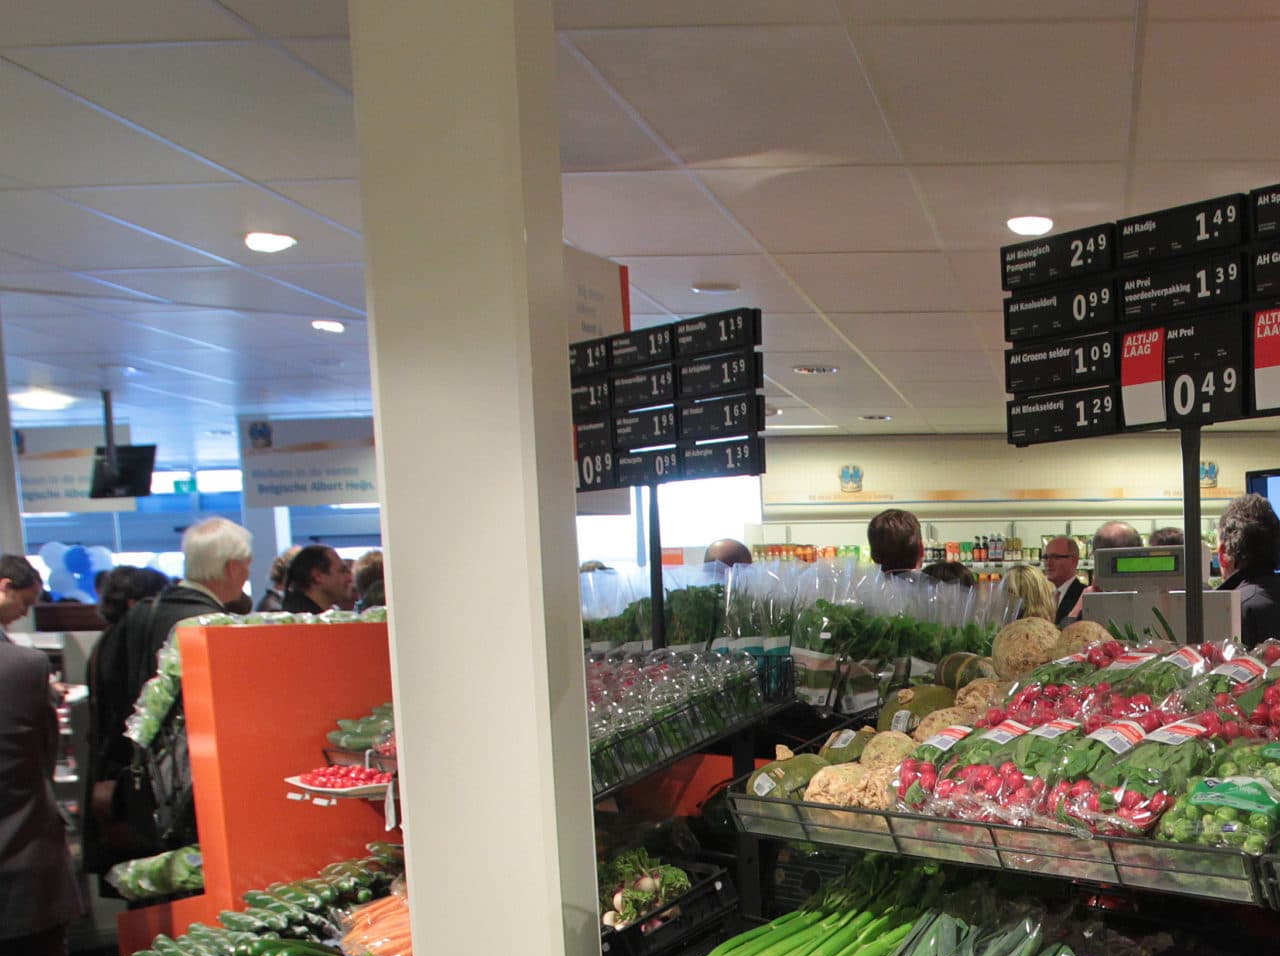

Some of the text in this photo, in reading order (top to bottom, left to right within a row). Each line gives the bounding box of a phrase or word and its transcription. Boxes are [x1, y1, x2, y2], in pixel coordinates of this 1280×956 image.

[1257, 195, 1270, 206] AH
[1123, 224, 1134, 235] AH
[1196, 205, 1236, 241] 1.49
[1070, 234, 1107, 267] 2.49
[1256, 254, 1270, 266] AH
[1124, 277, 1151, 292] AH Prei
[1196, 263, 1238, 298] 1.39
[1009, 303, 1020, 313] AH
[1072, 288, 1110, 321] 0.99
[1125, 331, 1159, 347] ALTIJD
[1167, 326, 1195, 340] AH Prei
[1010, 346, 1071, 365] AH Groene selder
[1074, 342, 1111, 374] 1.09
[1123, 343, 1152, 358] LAAG
[1173, 368, 1237, 416] 0.49
[1011, 405, 1022, 415] AH
[1075, 396, 1113, 427] 1.29
